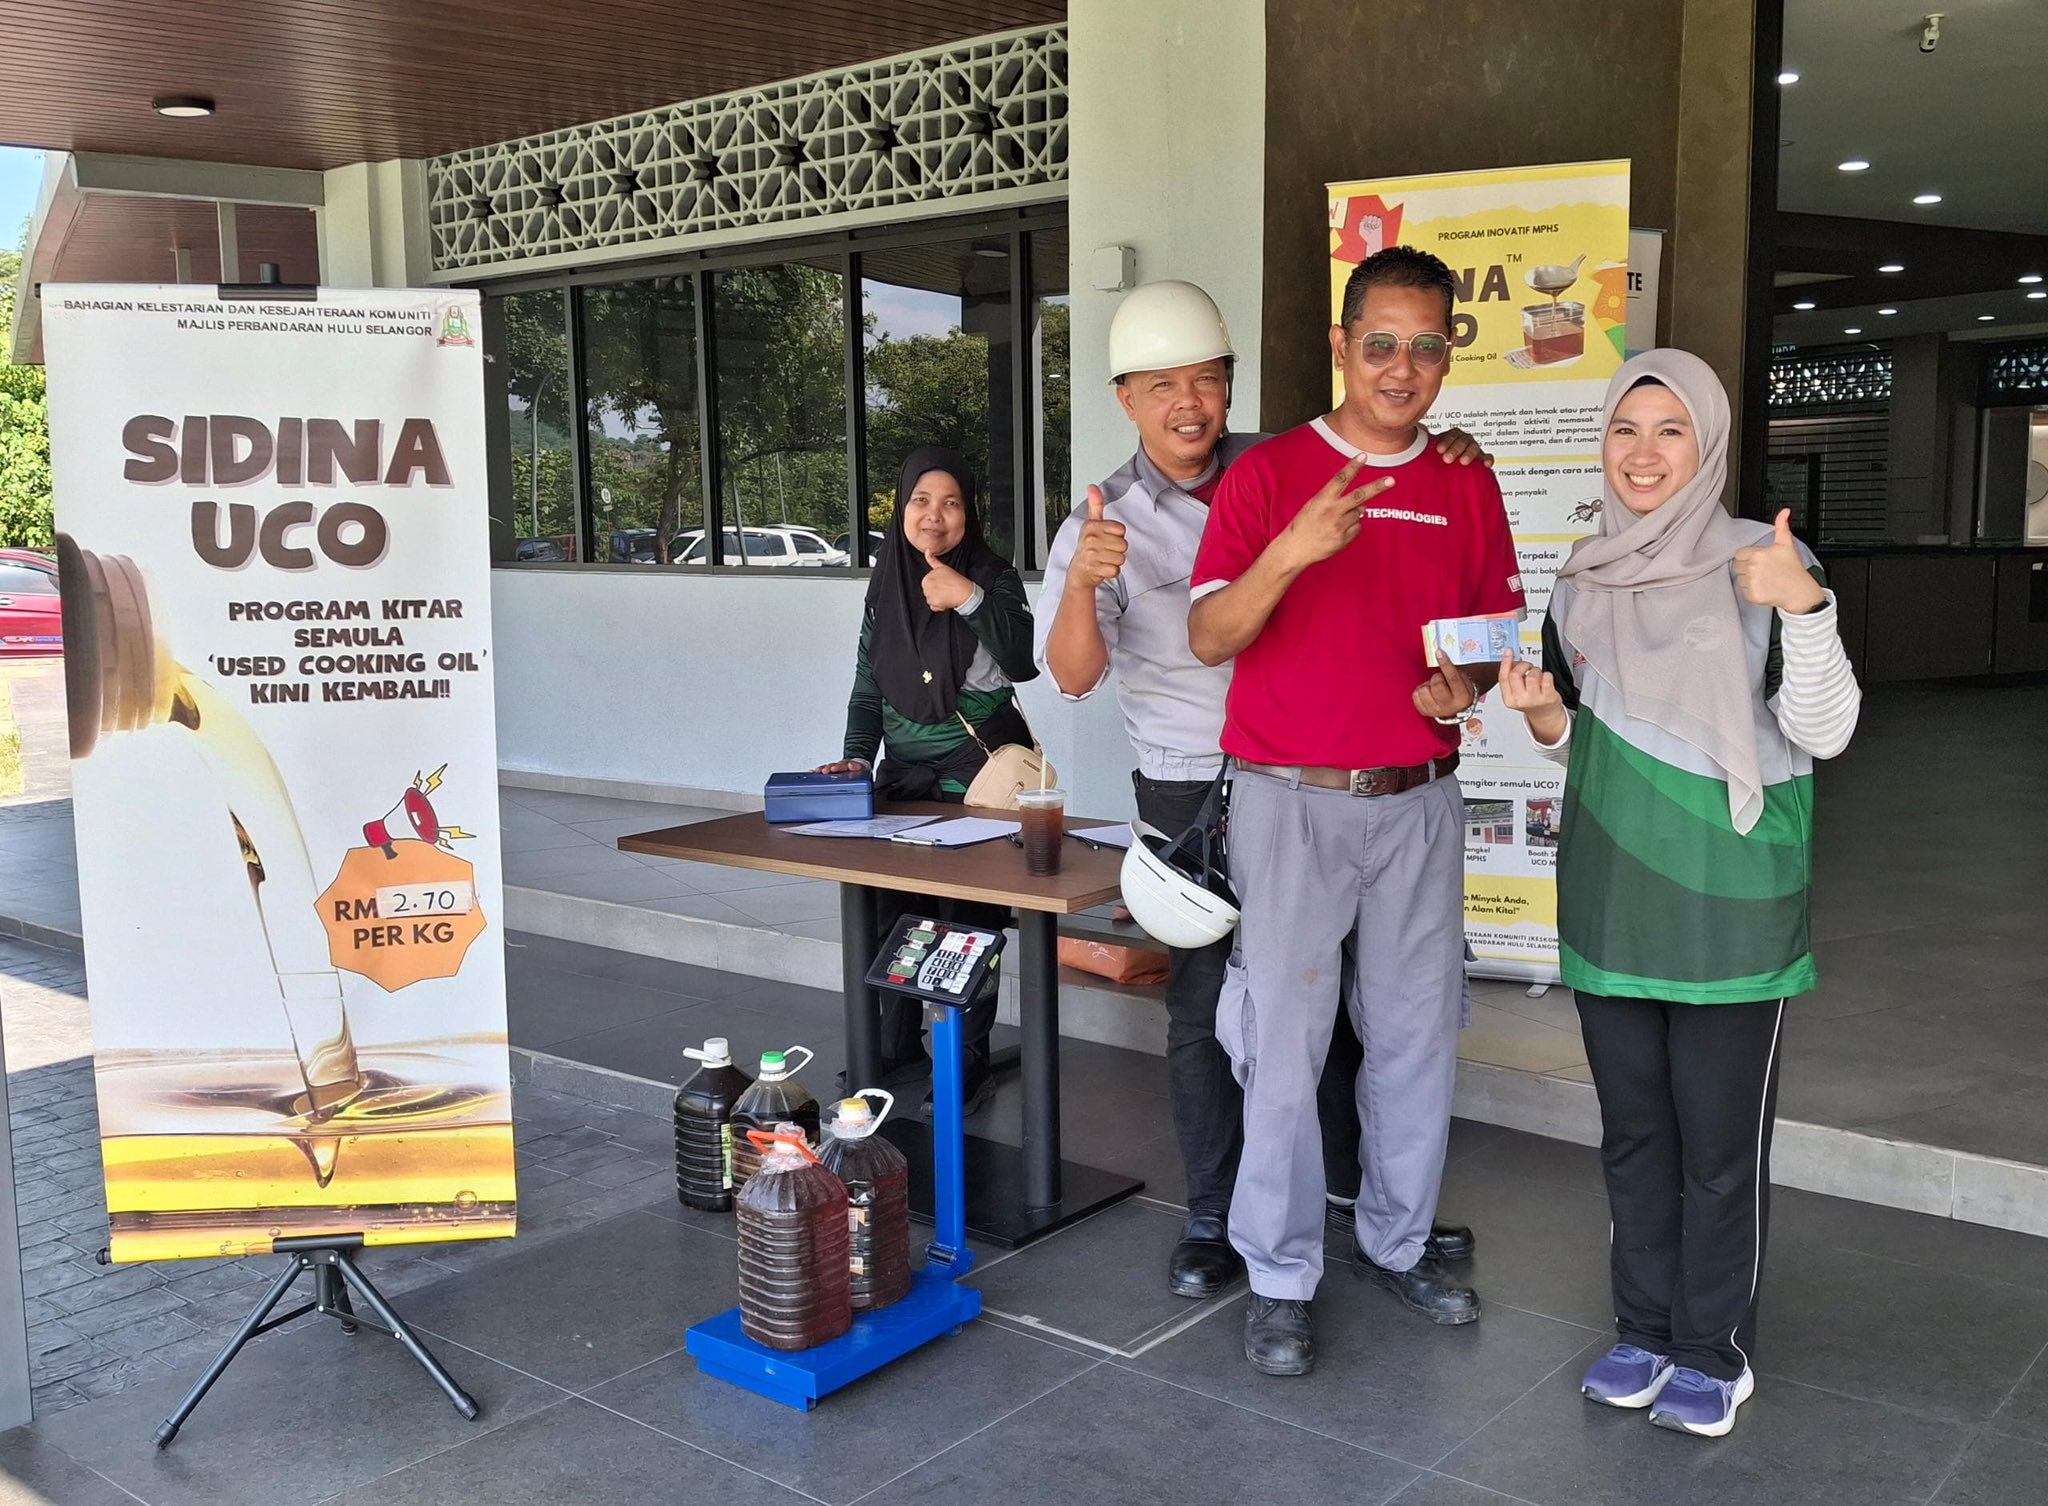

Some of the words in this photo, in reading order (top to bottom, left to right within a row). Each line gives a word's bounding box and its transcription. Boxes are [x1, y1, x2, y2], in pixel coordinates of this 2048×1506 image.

[1438, 229, 1485, 242] PROGRAM
[1486, 226, 1531, 238] INOVATIF
[1532, 223, 1559, 235] MPHS
[1451, 264, 1511, 303] NA
[64, 300, 133, 311] BAHAGIAN
[137, 302, 224, 314] KELESTARIAN
[228, 304, 255, 315] DAN
[259, 305, 365, 319] KESEJAHTERAAN
[369, 308, 431, 321] KOMUNITI
[177, 319, 225, 330] MAJLIS
[228, 320, 324, 333] PERBANDARAN
[327, 324, 362, 334] HULU
[365, 325, 432, 336] SELANGOR
[1455, 353, 1485, 363] Cooking
[1486, 352, 1497, 361] Oil
[1444, 411, 1462, 419] UCO
[1463, 410, 1488, 418] adalah
[1490, 408, 1517, 418] minyak
[1518, 408, 1533, 416] dan
[1579, 405, 1604, 414] produ
[1483, 420, 1517, 428] daripada
[1558, 416, 1594, 424] memasak
[1496, 429, 1519, 437] dalam
[1523, 427, 1552, 435] industri
[1520, 438, 1547, 447] segera,
[121, 414, 453, 487] SIDINA
[1498, 467, 1527, 476] masak
[1528, 467, 1560, 477] dengan
[1562, 467, 1582, 475] cara
[1584, 466, 1604, 474] sala
[1514, 488, 1548, 498] penyakit
[1365, 508, 1448, 526] TECHNOLOGIES
[191, 501, 389, 571] UCO
[1517, 550, 1559, 561] Terpakai
[228, 600, 370, 621] PROGRAM
[382, 599, 463, 620] KITAR
[294, 626, 404, 648] SEMULA
[1526, 646, 1542, 655] Ter
[298, 653, 426, 675] COOKING
[250, 683, 310, 704] KINI
[322, 679, 450, 701] KEMBALI!!
[1476, 751, 1504, 759] haiwan
[1500, 780, 1531, 789] semula
[1533, 780, 1560, 790] UCO?
[1528, 849, 1549, 857] Booth
[334, 897, 379, 922] RM
[392, 889, 456, 912] 2.70
[1470, 894, 1501, 905] Minyak
[1503, 896, 1530, 906] Anda,
[1471, 905, 1494, 914] Alam
[353, 925, 405, 950] PER
[413, 922, 455, 945] KG
